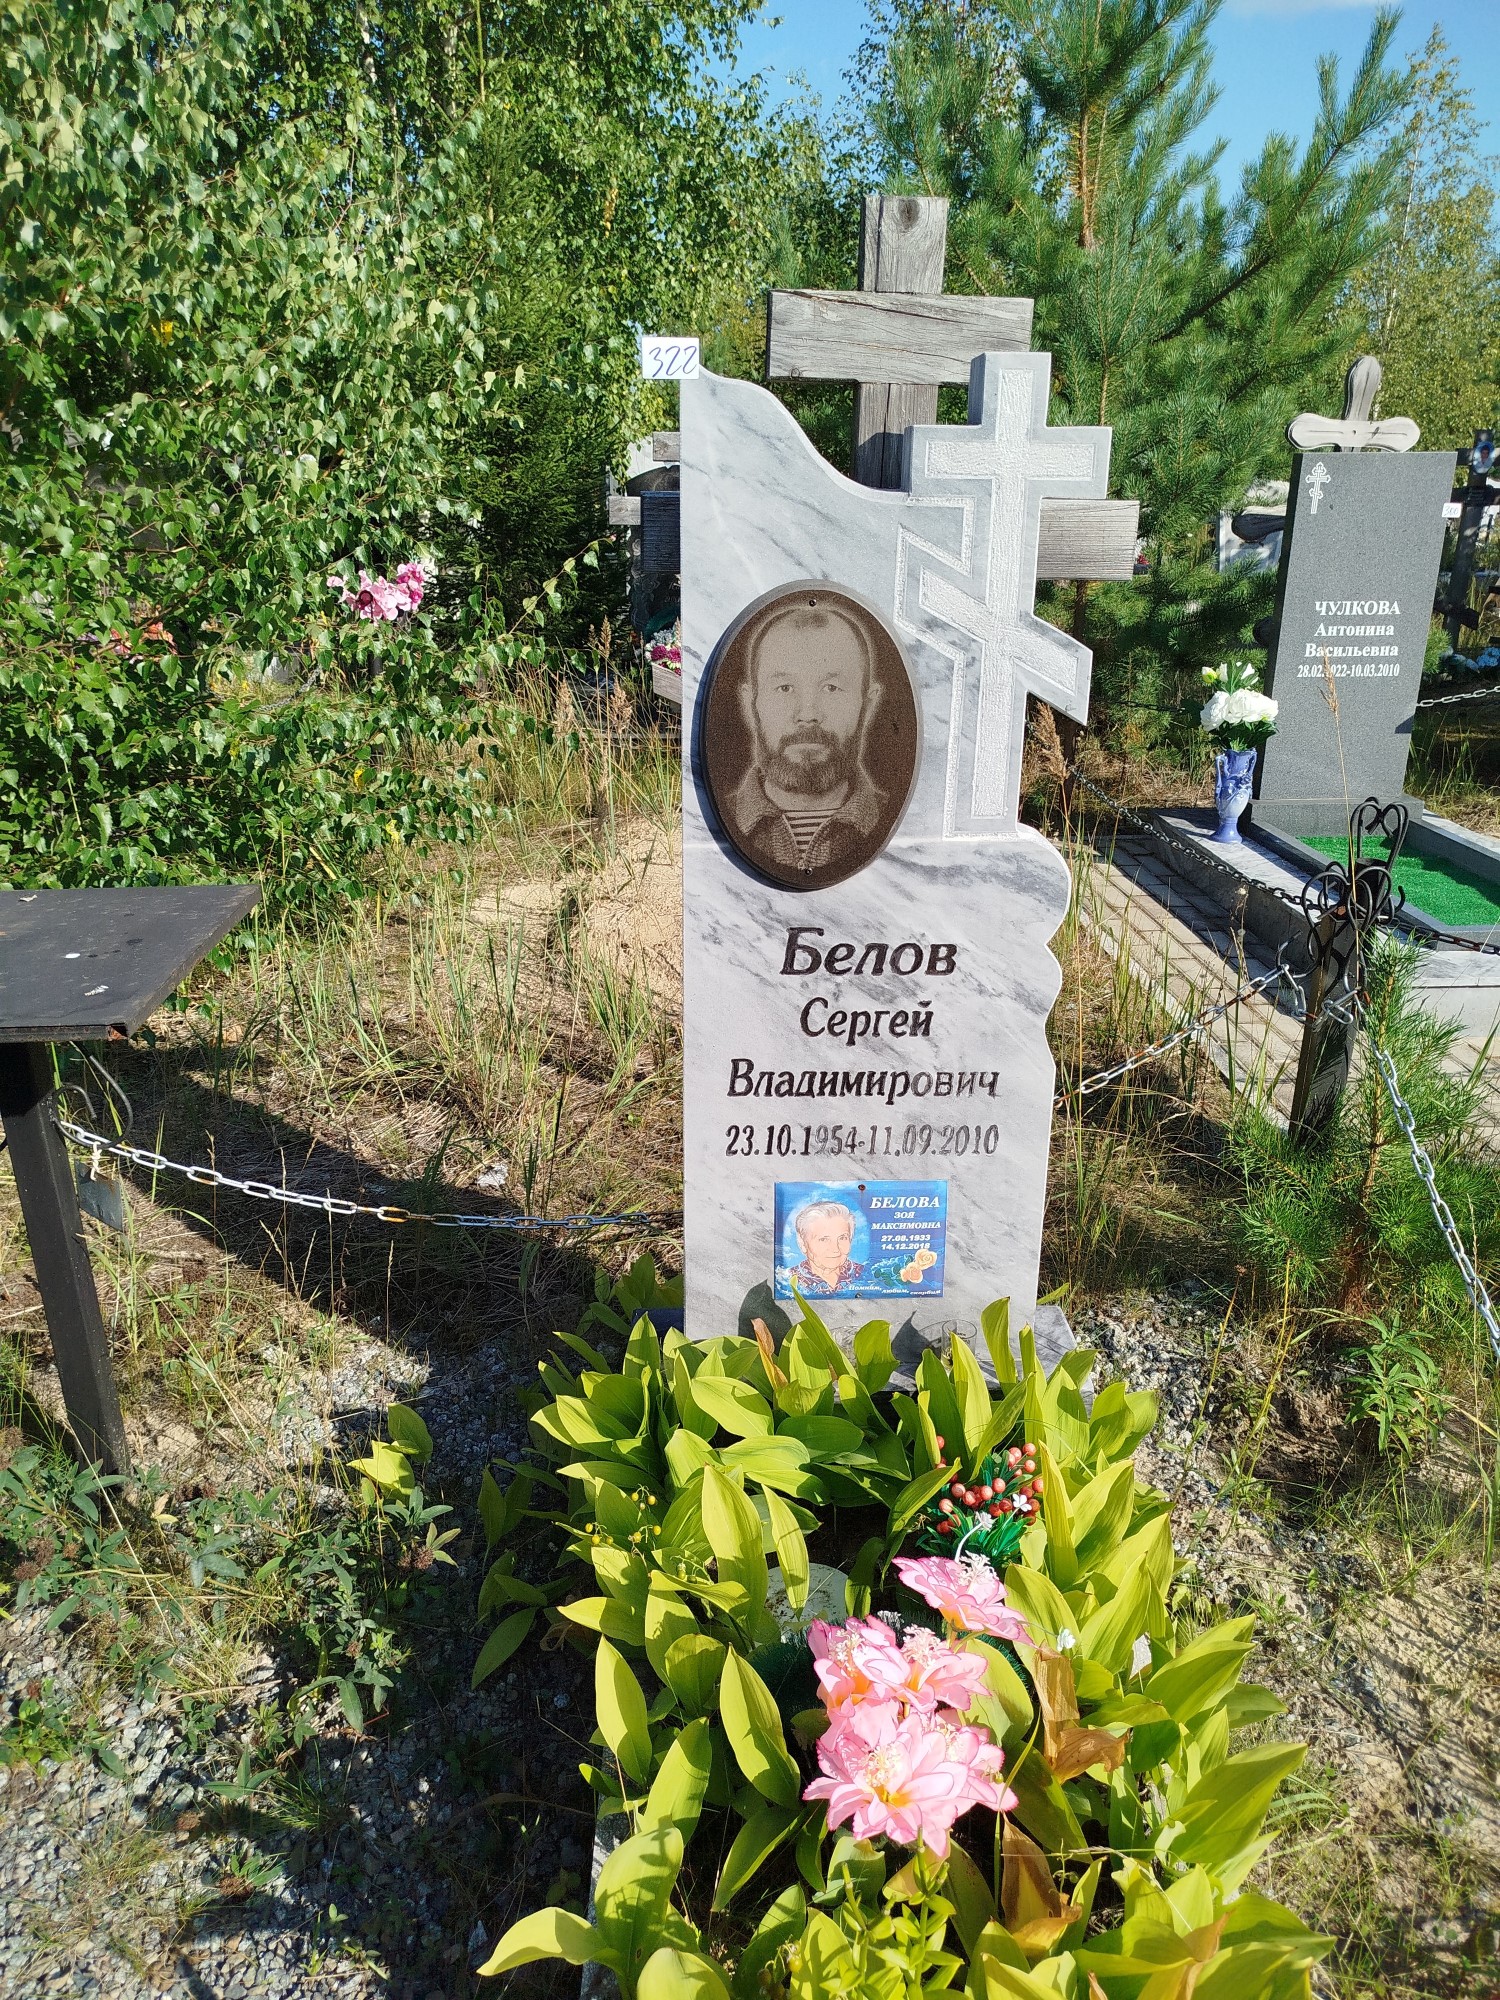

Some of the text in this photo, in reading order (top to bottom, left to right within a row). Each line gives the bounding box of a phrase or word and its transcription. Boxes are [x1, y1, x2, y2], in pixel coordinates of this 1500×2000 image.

[648, 345, 698, 378] 322
[1315, 600, 1401, 616] ЧУЛКОВА
[1314, 622, 1395, 637] Антонина
[1304, 642, 1399, 658] Васильевна
[1297, 663, 1400, 678] 28.02.922-10.03.2010
[779, 926, 958, 976] Белов
[800, 996, 934, 1046] Сергей
[726, 1058, 1000, 1106] Владимирович
[869, 1196, 941, 1209] БЕЛОВА
[893, 1211, 916, 1219] ЗОЯ
[871, 1221, 941, 1230] МАКСИМОВНА
